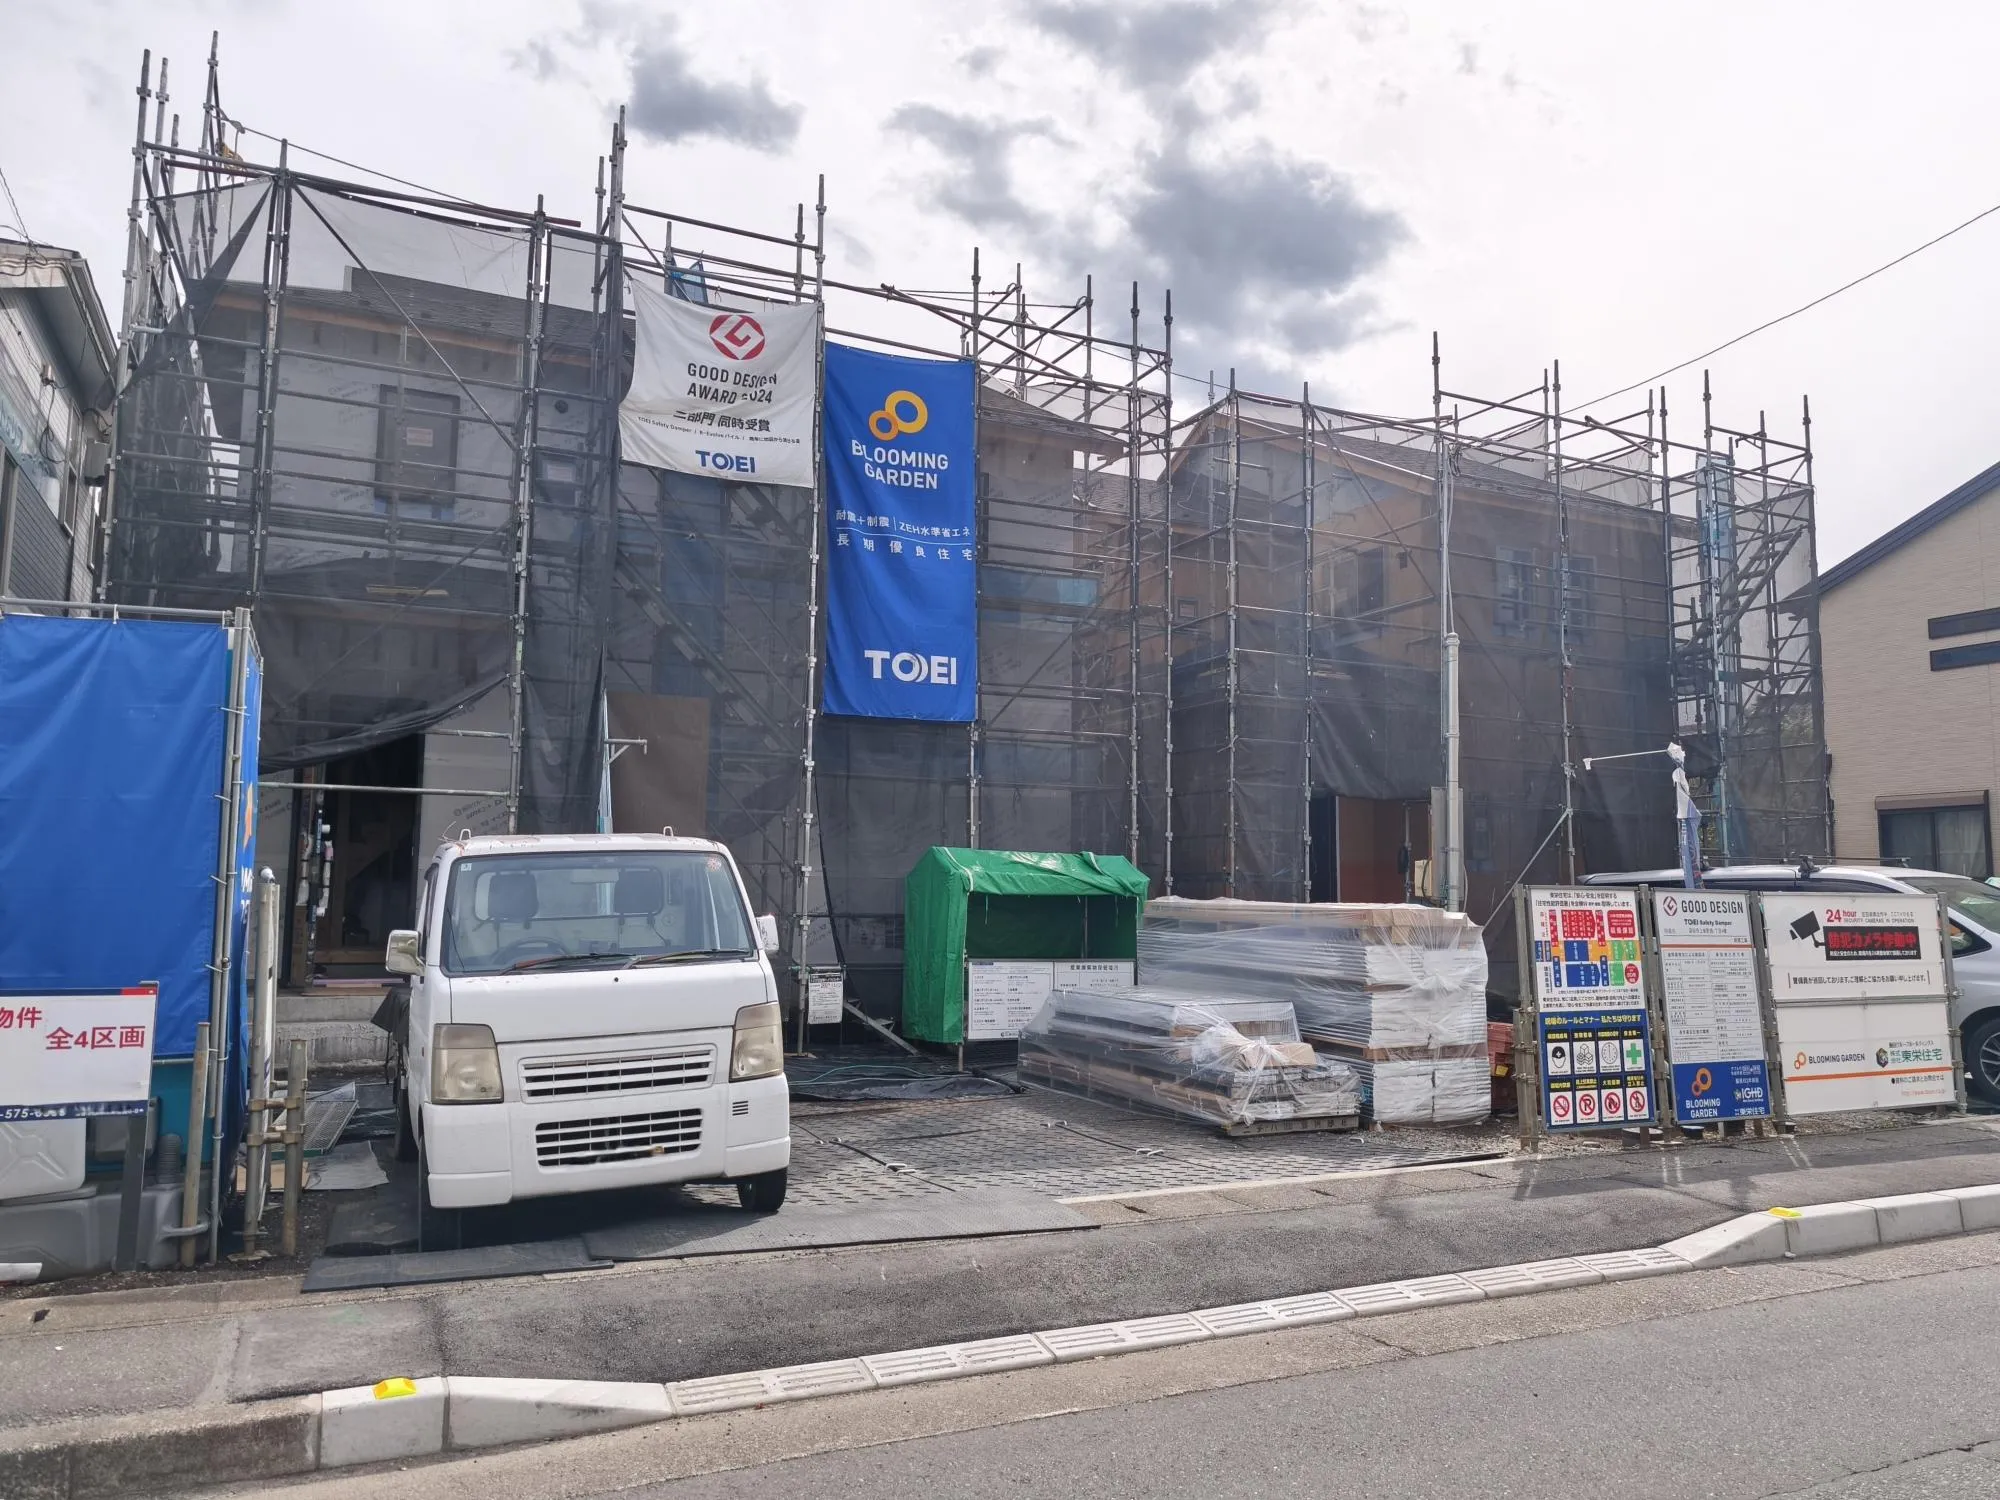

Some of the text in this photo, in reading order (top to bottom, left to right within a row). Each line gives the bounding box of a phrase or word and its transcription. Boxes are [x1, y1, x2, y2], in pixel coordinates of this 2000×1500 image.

[688, 362, 729, 383] GOOD
[687, 382, 737, 405] AWARD
[718, 415, 771, 432] 同時受賞
[695, 450, 756, 473] TOEI
[852, 439, 949, 471] BLOOMING
[864, 463, 938, 490] GARDEN
[864, 649, 957, 685] TOEI
[1681, 900, 1744, 914] GOOD DESIGN
[1825, 909, 1842, 923] 24
[1842, 910, 1857, 918] hour
[45, 1025, 146, 1051] 全4区画
[1808, 1053, 1865, 1064] BLOOMING GARDEN
[1901, 1048, 1943, 1062] 東栄住宅
[1685, 1098, 1721, 1109] BLOOMING
[1690, 1108, 1718, 1119] GARDEN
